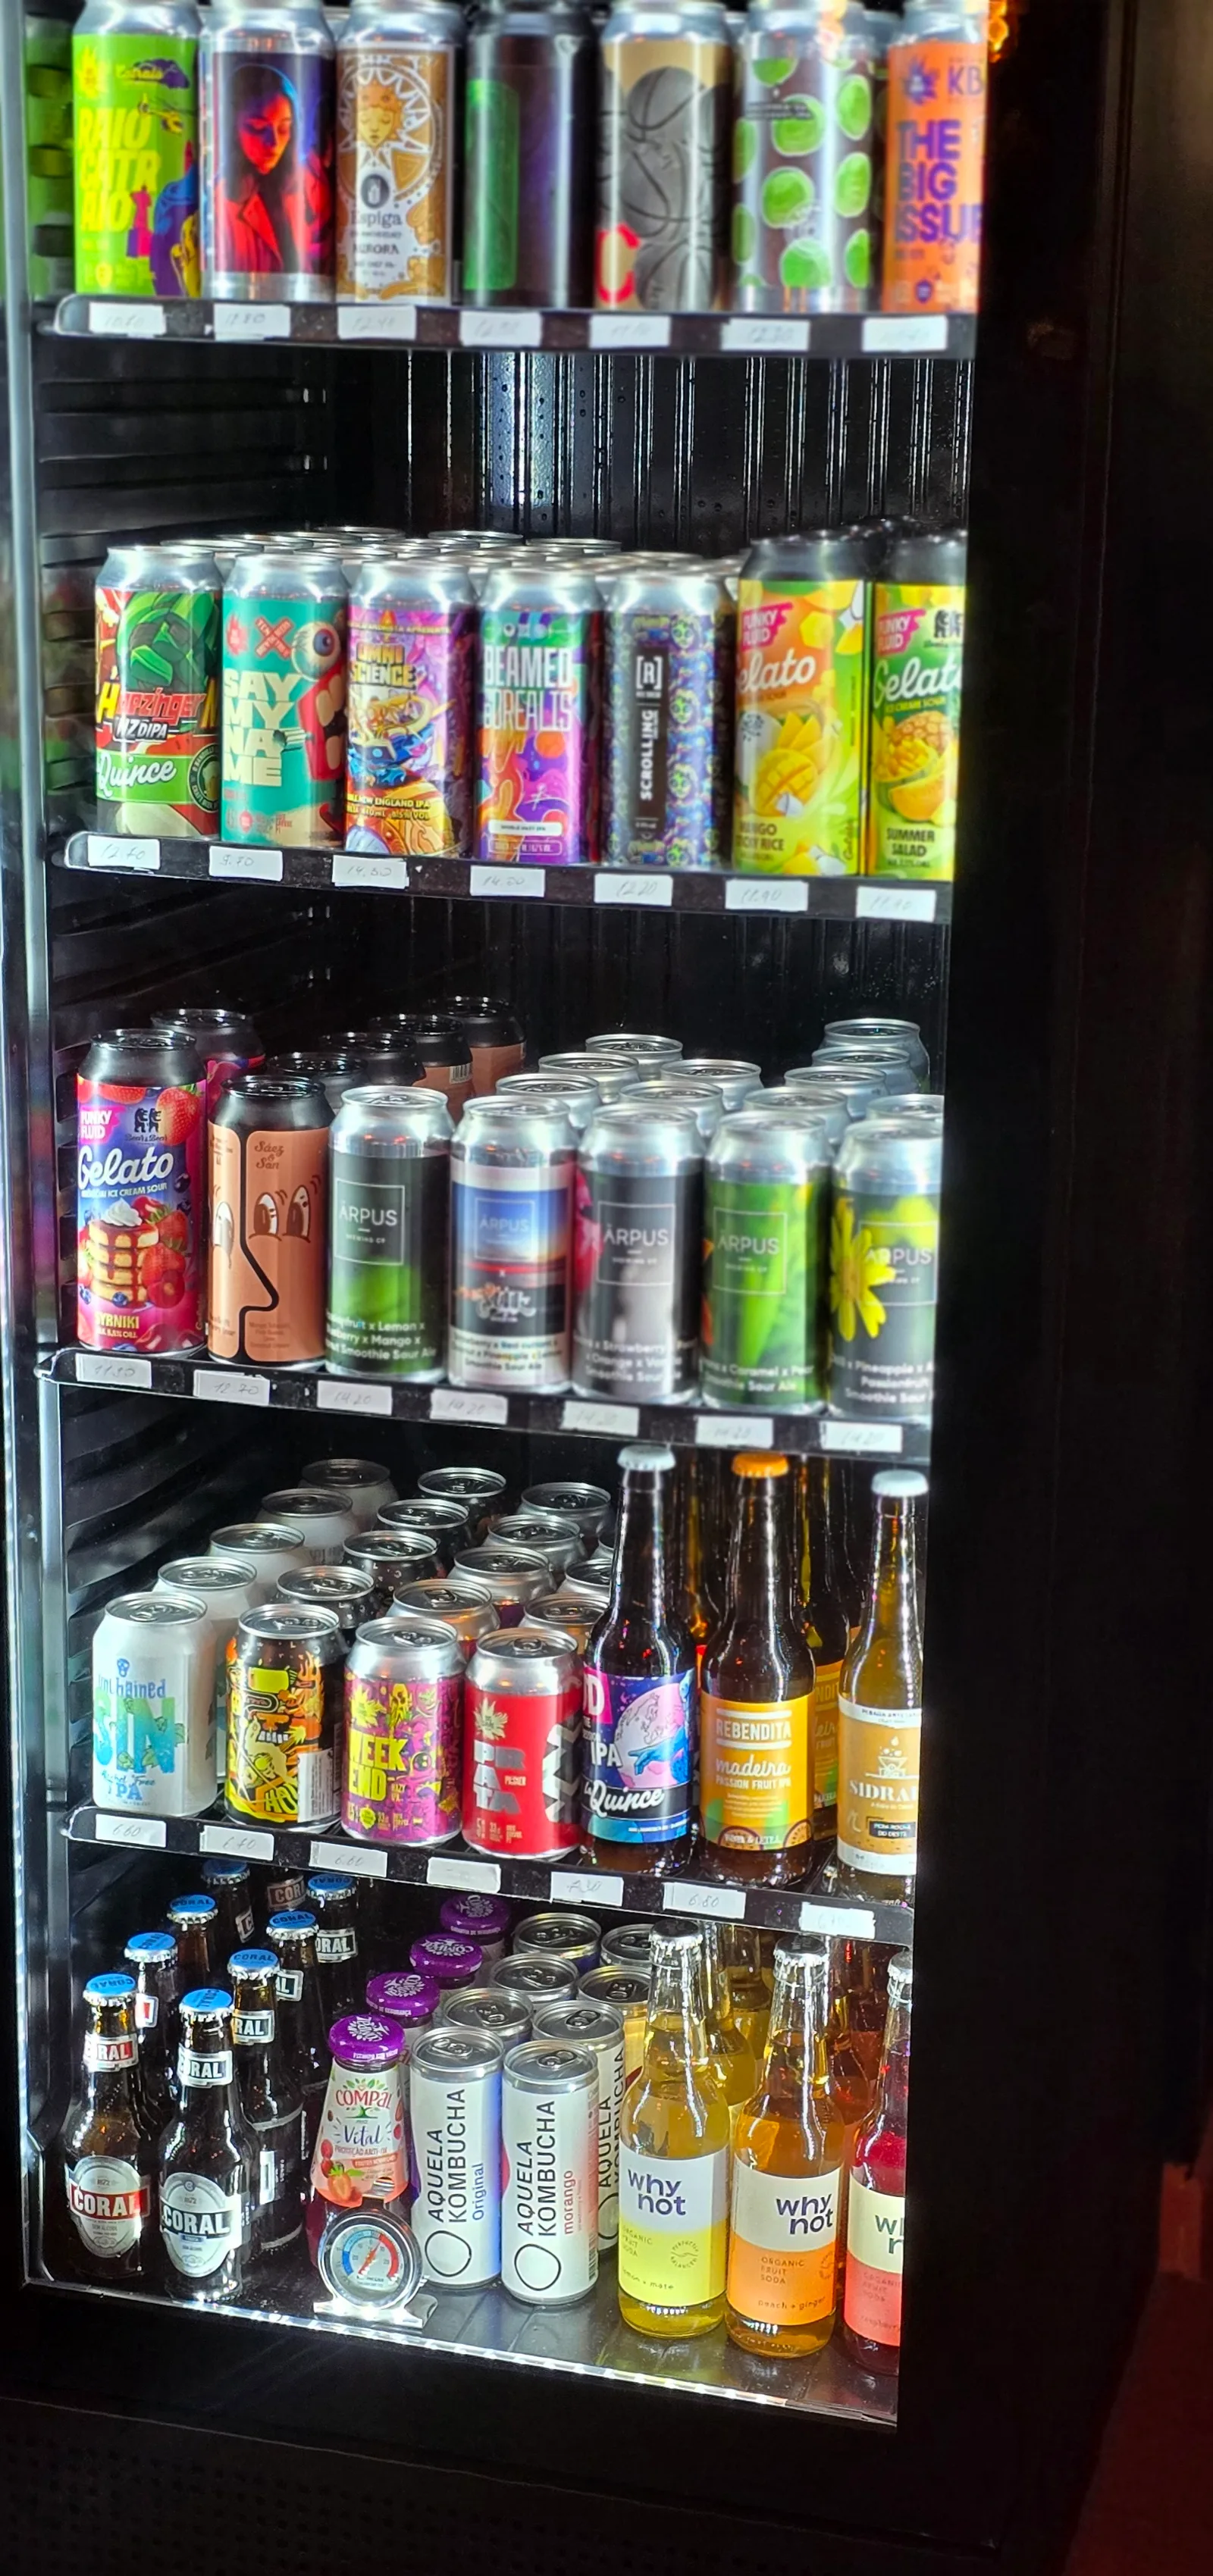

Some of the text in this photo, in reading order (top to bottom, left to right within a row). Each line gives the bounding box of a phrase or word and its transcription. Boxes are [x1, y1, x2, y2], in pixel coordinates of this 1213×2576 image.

[898, 119, 961, 161] THE
[899, 162, 957, 201] BIG
[349, 662, 416, 689] SCIENCE
[483, 646, 574, 687] BEAMED
[736, 648, 817, 695] elato
[224, 668, 300, 702] SAY
[224, 702, 293, 730] MY
[483, 688, 574, 731] BOREALIS
[137, 722, 168, 740] DIPA
[224, 728, 284, 759] NA
[640, 709, 654, 801] SCROLLING
[96, 752, 177, 799] Quince
[224, 756, 282, 787] ME
[375, 797, 414, 809] ENGLAND
[885, 828, 935, 842] SUMMER
[892, 843, 927, 857] SALAD
[81, 1113, 113, 1125] FUNKY
[81, 1125, 106, 1139] FLUID
[78, 1145, 174, 1188] Gelato
[255, 1157, 280, 1170] San
[119, 1186, 146, 1197] CREAM
[378, 1321, 418, 1332] Lemon
[371, 1334, 412, 1347] Mango
[392, 1348, 419, 1360] Sour
[748, 1379, 776, 1392] Sour
[92, 1689, 175, 1773] SIN
[716, 1719, 791, 1741] REBENDITA
[349, 1729, 408, 1771] WEEK
[591, 1742, 624, 1767] IPA
[716, 1752, 792, 1778] madeira
[349, 1759, 387, 1801] END
[716, 1774, 750, 1790] PASSION
[751, 1779, 777, 1791] FRUIT
[590, 1779, 666, 1818] Quince
[271, 1912, 315, 1926] CORAL
[233, 1953, 274, 1963] CORAL
[316, 1937, 351, 1954] ORAL
[90, 1977, 134, 1990] CORAL
[236, 2019, 265, 2037] RAL
[97, 2041, 133, 2061] RAL
[189, 2058, 225, 2079] RAL
[343, 2124, 384, 2147] Vital
[599, 2096, 611, 2187] AQUELA
[447, 2089, 467, 2223] KOMBUCHA
[537, 2101, 556, 2236] KOMBUCHA
[427, 2129, 445, 2223] AQUELA
[517, 2141, 535, 2236] AQUELA
[628, 2168, 682, 2197] why
[74, 2189, 136, 2218] CORAL
[472, 2162, 487, 2221] Original
[563, 2171, 575, 2235] morango
[638, 2192, 686, 2215] not
[776, 2193, 832, 2217] why
[162, 2205, 230, 2236] CORAL
[789, 2210, 833, 2235] not
[760, 2255, 805, 2268] ORGANIC
[760, 2265, 787, 2276] FRUIT
[760, 2274, 787, 2285] SODA
